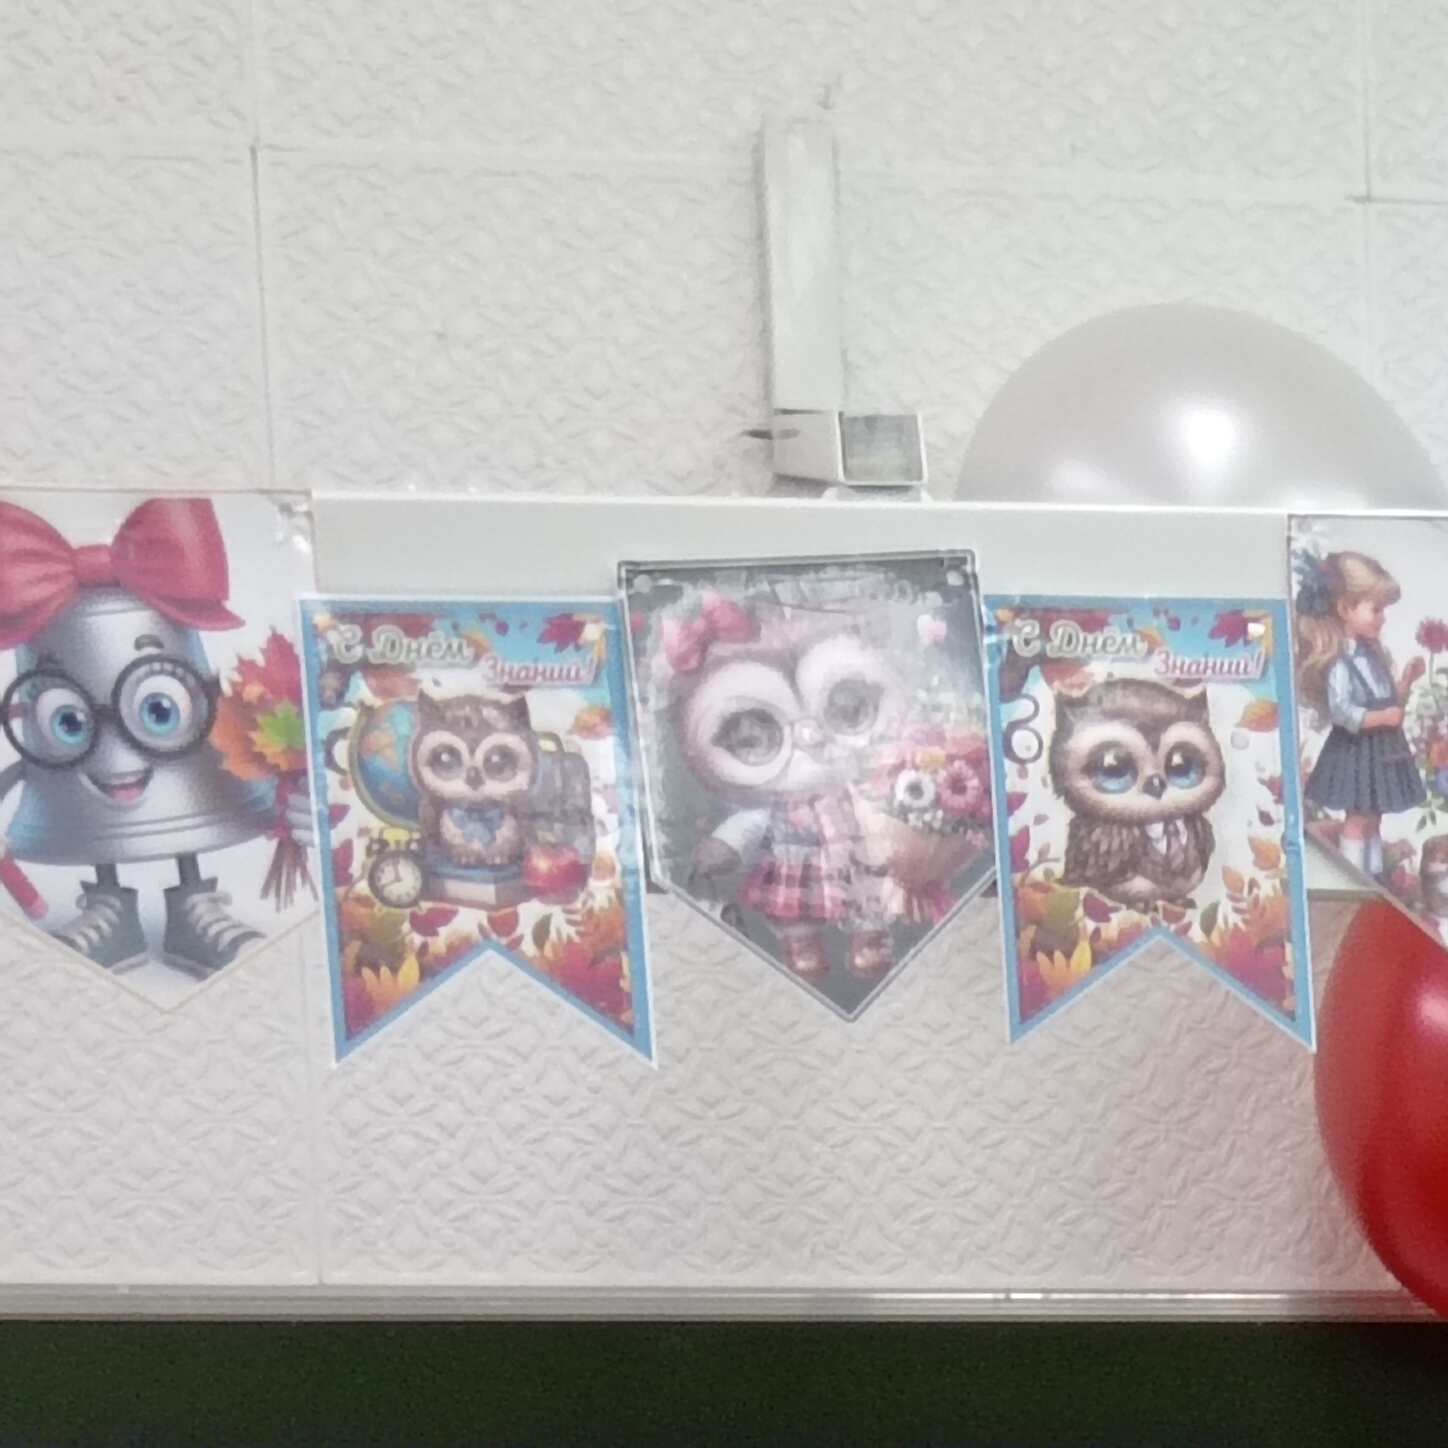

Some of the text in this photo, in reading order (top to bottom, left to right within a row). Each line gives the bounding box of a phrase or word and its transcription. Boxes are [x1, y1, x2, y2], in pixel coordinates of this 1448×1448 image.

[328, 624, 474, 664] С Днём
[1013, 619, 1147, 657] С Днём
[482, 654, 598, 685] Знаний!
[1153, 648, 1264, 679] Знаний!
